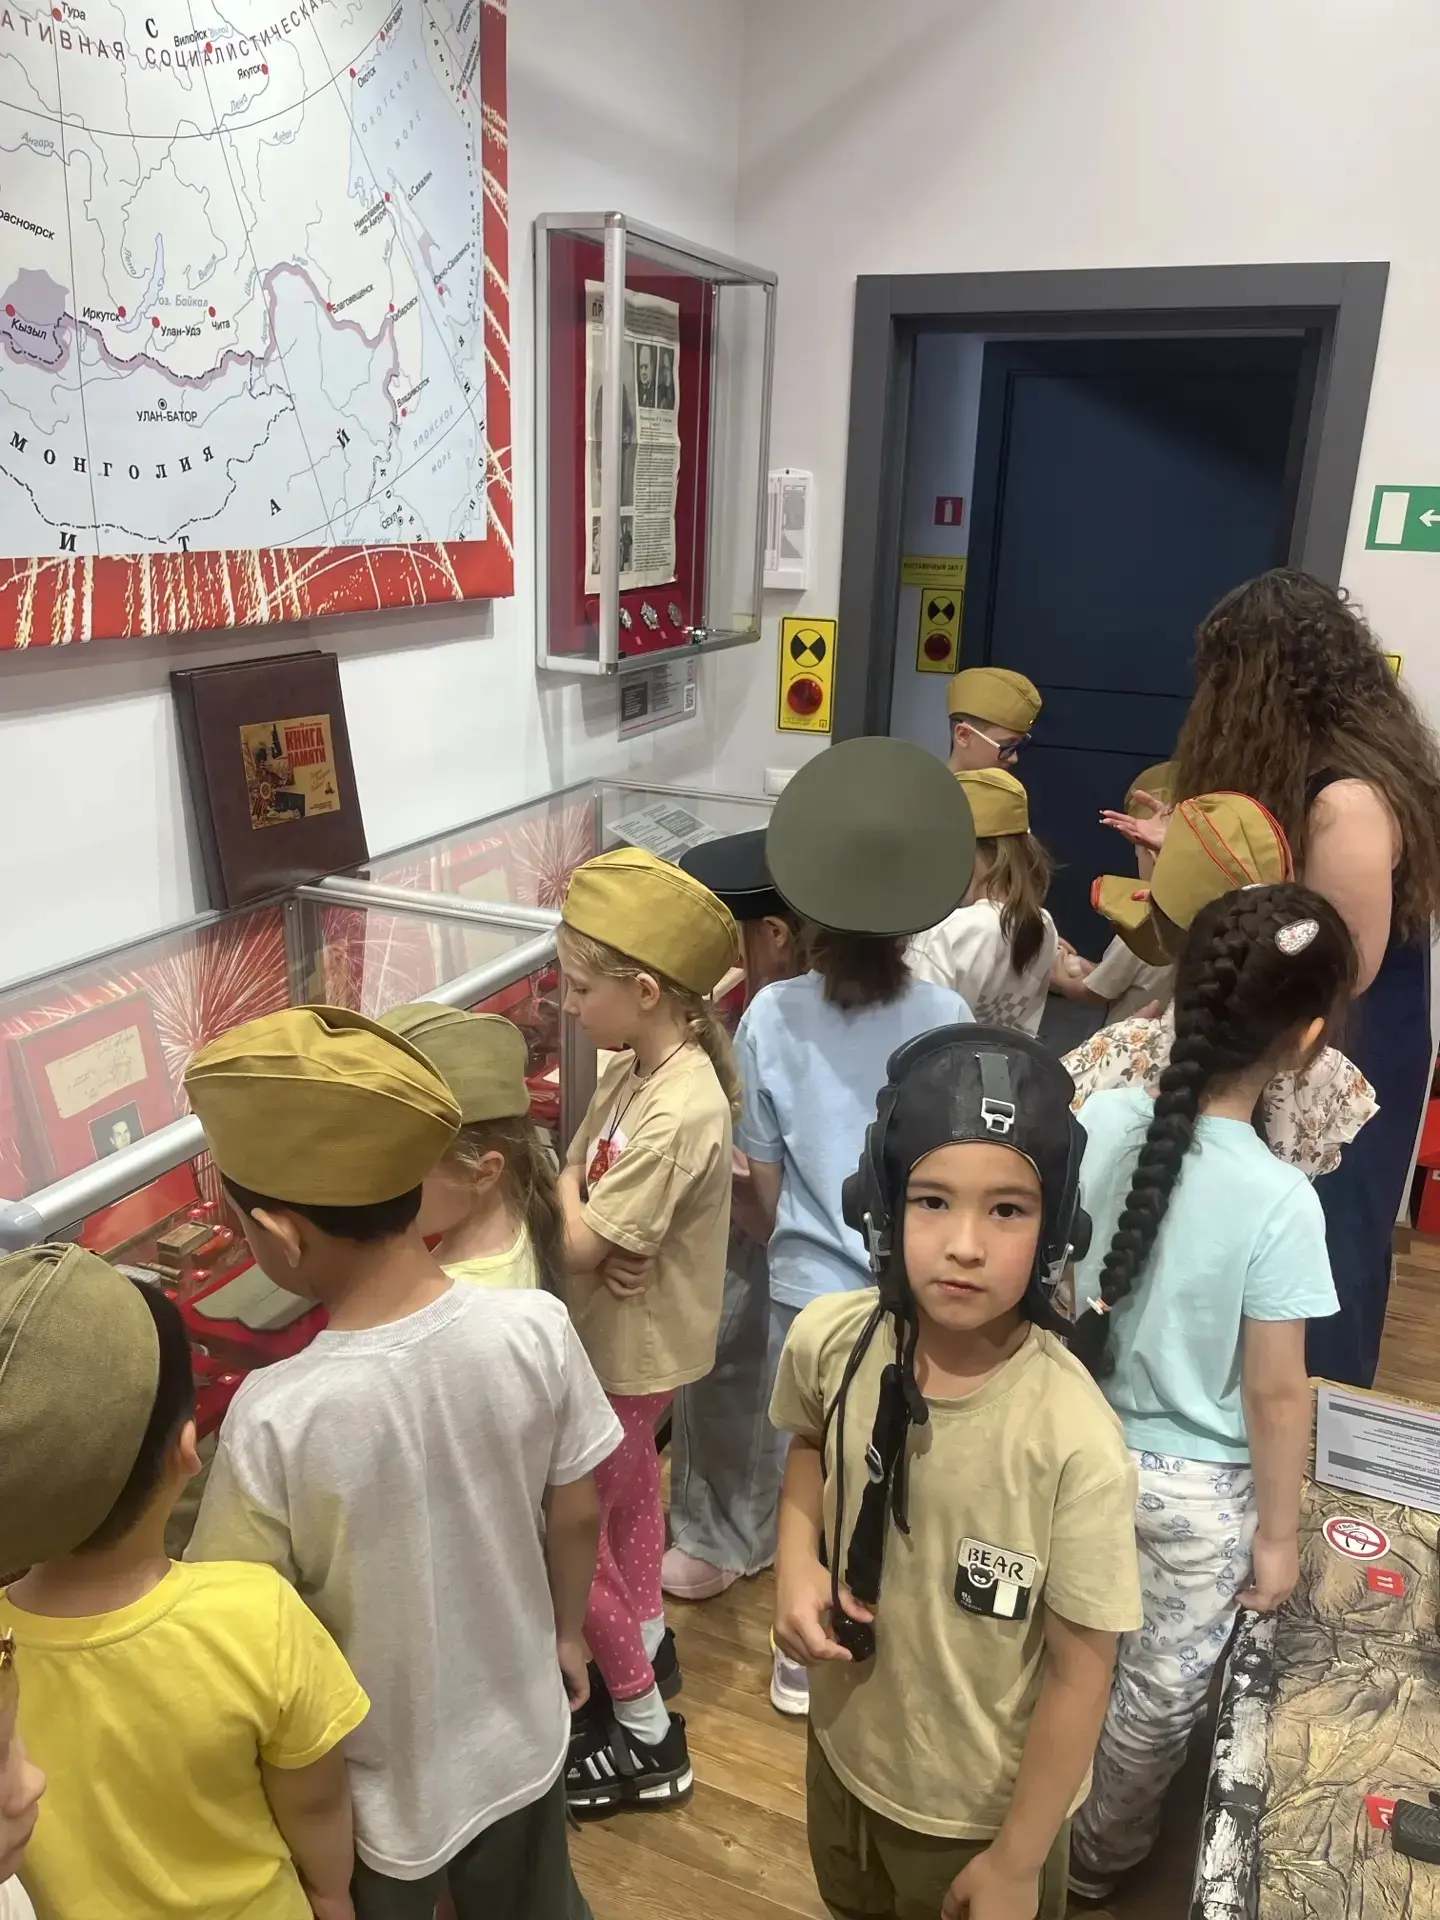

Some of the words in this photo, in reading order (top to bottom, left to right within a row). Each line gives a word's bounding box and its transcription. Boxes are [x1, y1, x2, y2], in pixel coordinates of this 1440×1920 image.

[62, 1, 86, 21] Тура
[145, 0, 324, 72] СОЦИАЛИСТИЧЕСКА
[174, 30, 207, 47] Вилюйск
[237, 64, 262, 80] Якутск
[357, 67, 376, 88] Охотск
[231, 93, 248, 112] Лена
[21, 132, 54, 149] Ангара
[124, 247, 136, 275] Лена
[175, 294, 208, 307] Байкал
[391, 296, 418, 322] Хабаровск
[83, 307, 120, 322] Иркутск
[212, 320, 230, 330] Чита
[11, 318, 47, 340] Кызыл
[161, 326, 201, 337] Улан-Удэ
[397, 377, 430, 408] Владивосток
[137, 411, 197, 422] УЛАН-БАТОР
[413, 405, 454, 450] ЯПОНСКОЕ
[9, 431, 214, 479] МОНГОЛИЯ
[285, 727, 324, 751] КНИГА
[288, 747, 326, 768] ПАМЯТИ
[967, 1548, 1024, 1581] BEAR
